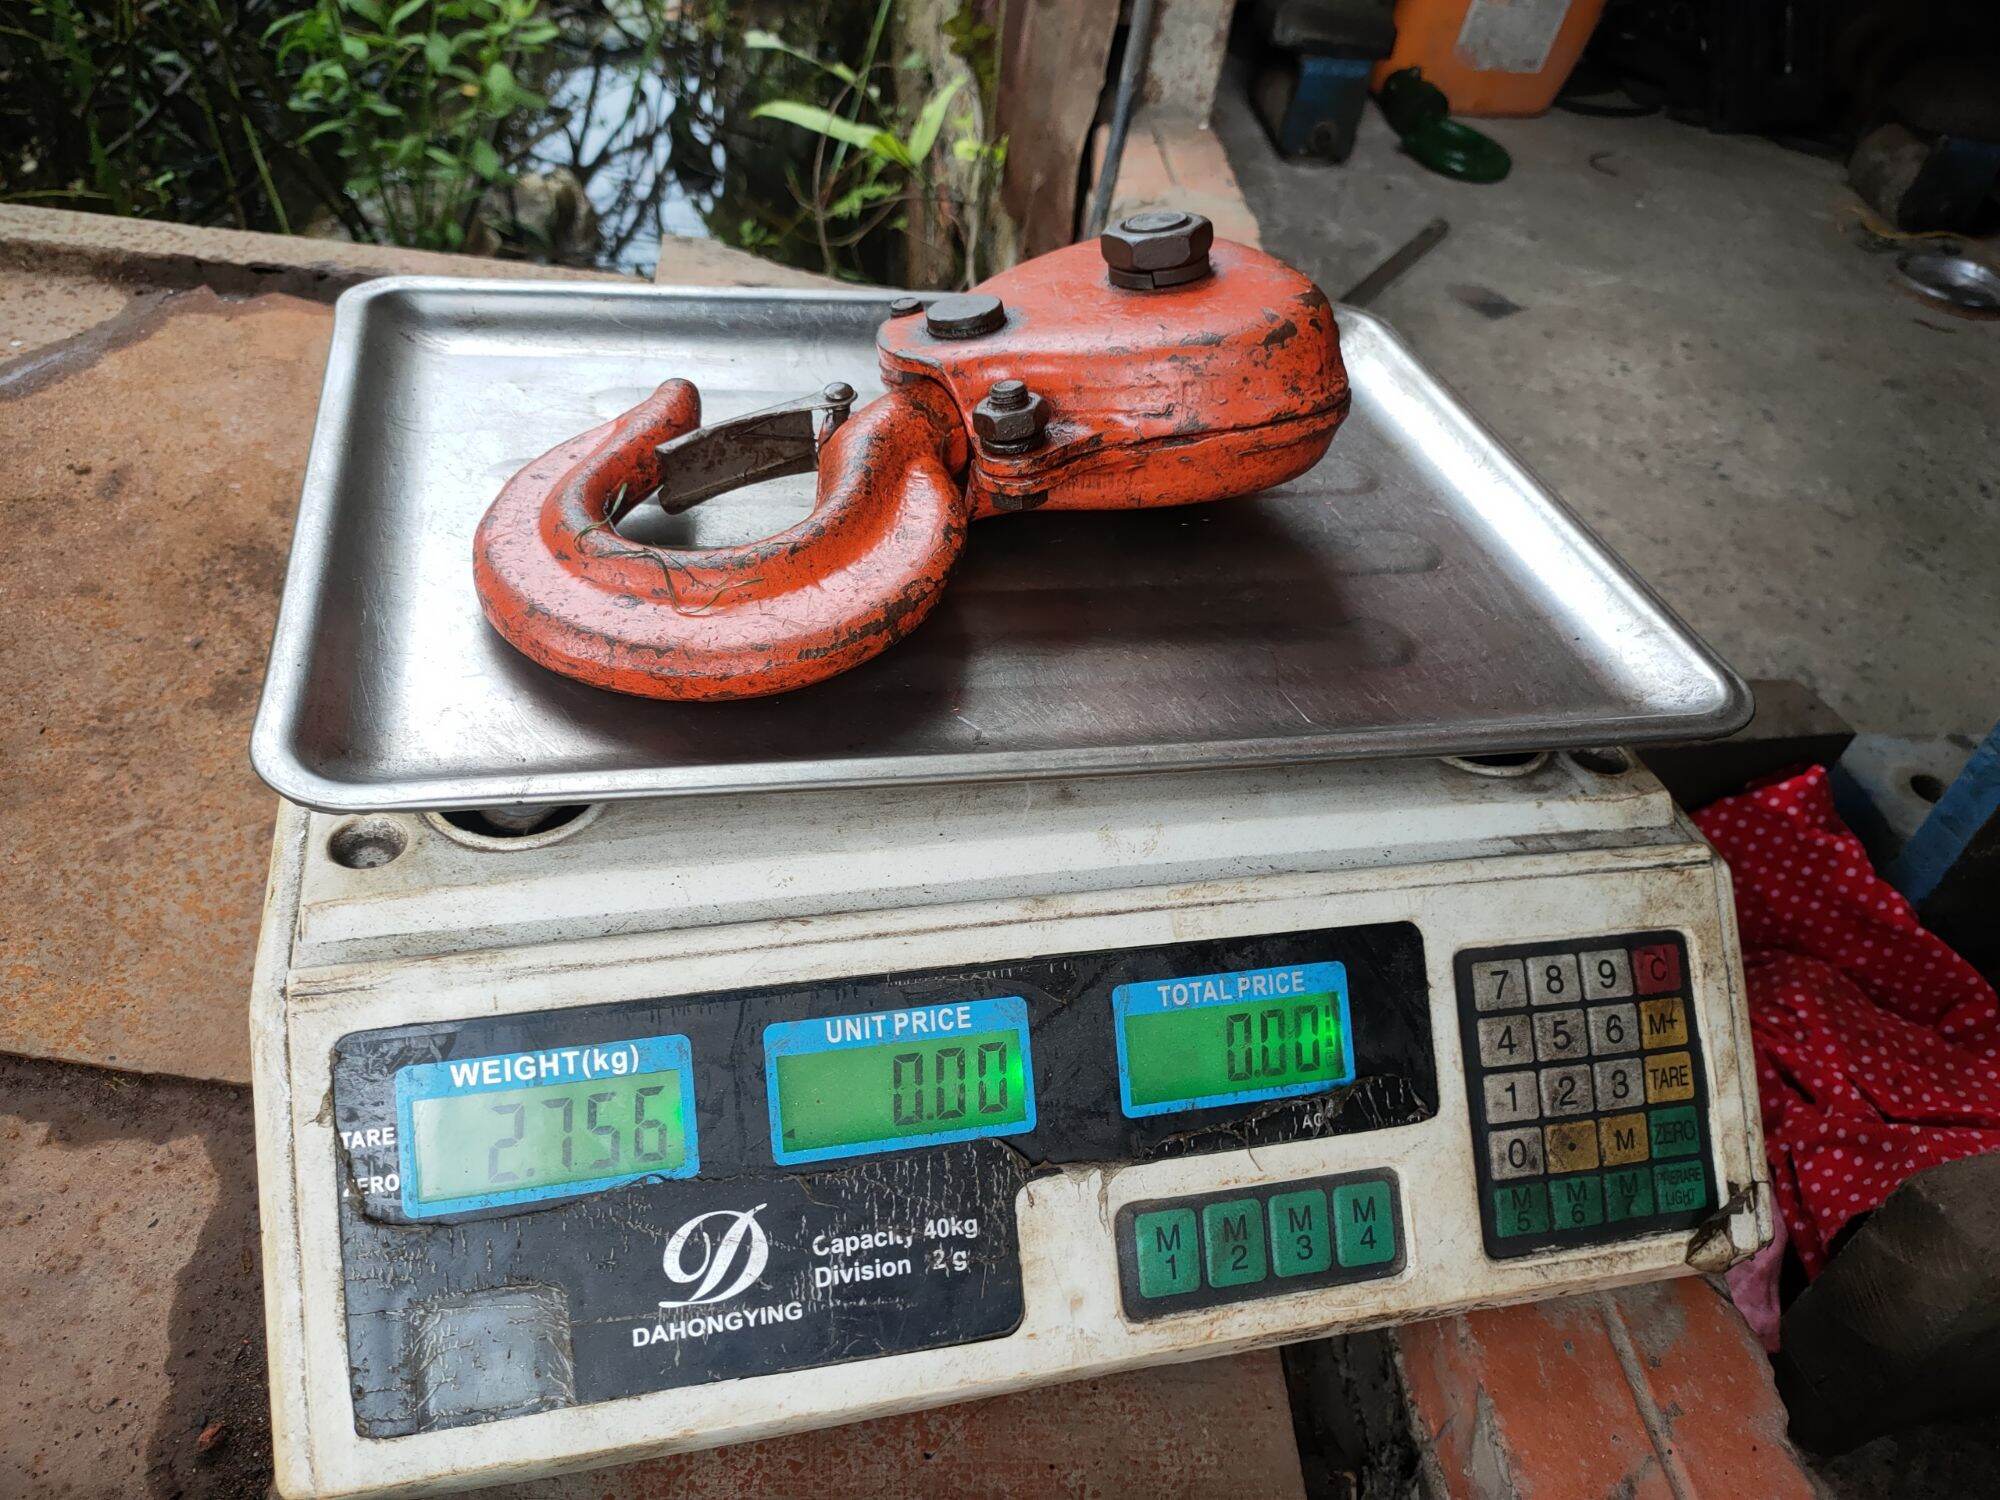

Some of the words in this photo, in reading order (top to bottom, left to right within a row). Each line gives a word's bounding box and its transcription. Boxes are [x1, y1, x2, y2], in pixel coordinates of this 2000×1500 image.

[1490, 969, 1509, 1000] 7
[1546, 964, 1565, 995] 8
[1597, 959, 1617, 989] 9
[1651, 959, 1668, 982] C
[1157, 981, 1232, 1007] TOTAL
[1238, 970, 1306, 999] PRICE
[825, 1015, 887, 1043] UNIT
[894, 1006, 972, 1036] PRICE
[1553, 1020, 1572, 1051] 5
[1605, 1014, 1624, 1044] 6
[1649, 1013, 1678, 1036] M+
[1497, 1025, 1517, 1055] 4
[449, 1044, 640, 1088] WEIGHT(kg)
[1649, 1065, 1689, 1090] TARE
[893, 1041, 1007, 1127] 0.00
[1504, 1081, 1518, 1112] 1
[1558, 1076, 1578, 1107] 2
[1611, 1069, 1630, 1099] 3
[339, 1127, 396, 1149] TARE
[488, 1085, 668, 1184] 2.756
[1615, 1128, 1635, 1152] M
[1654, 1120, 1696, 1145] ZERO
[1507, 1138, 1527, 1169] 0
[1511, 1188, 1532, 1210] M
[1566, 1182, 1587, 1203] M
[1288, 1205, 1313, 1233] M
[1352, 1196, 1377, 1224] M
[1517, 1211, 1531, 1231] 5
[1571, 1204, 1585, 1225] 6
[924, 1217, 978, 1242] 40kg
[1156, 1224, 1181, 1253] M
[1223, 1214, 1248, 1241] M
[1360, 1227, 1377, 1249] 4
[1231, 1245, 1249, 1271] 2
[1296, 1235, 1313, 1260] 3
[815, 1257, 912, 1288] Division
[1165, 1255, 1177, 1280] 1
[632, 1301, 804, 1348] DAHONGYING
